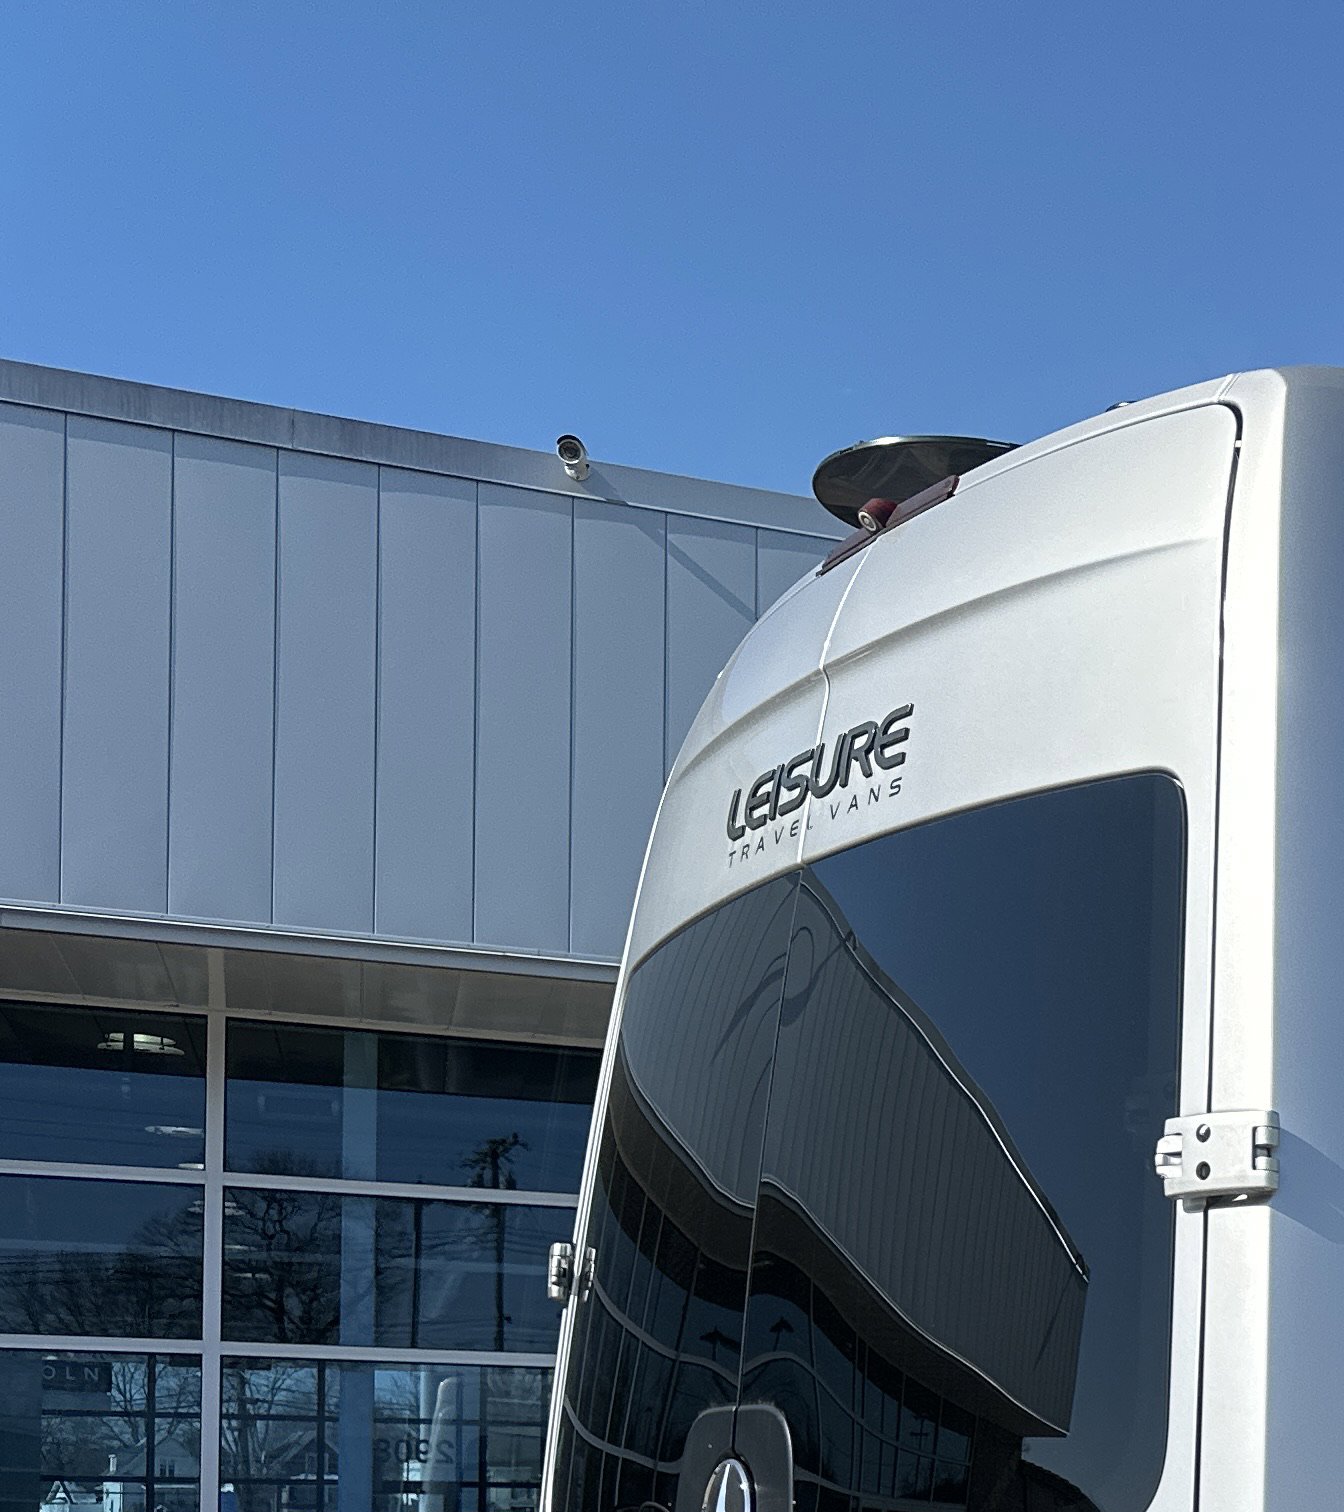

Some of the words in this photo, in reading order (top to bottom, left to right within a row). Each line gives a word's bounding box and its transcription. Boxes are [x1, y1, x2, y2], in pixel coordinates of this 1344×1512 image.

[726, 702, 915, 842] LEISURE
[728, 815, 813, 868] TRAVEL
[829, 776, 903, 820] VANS
